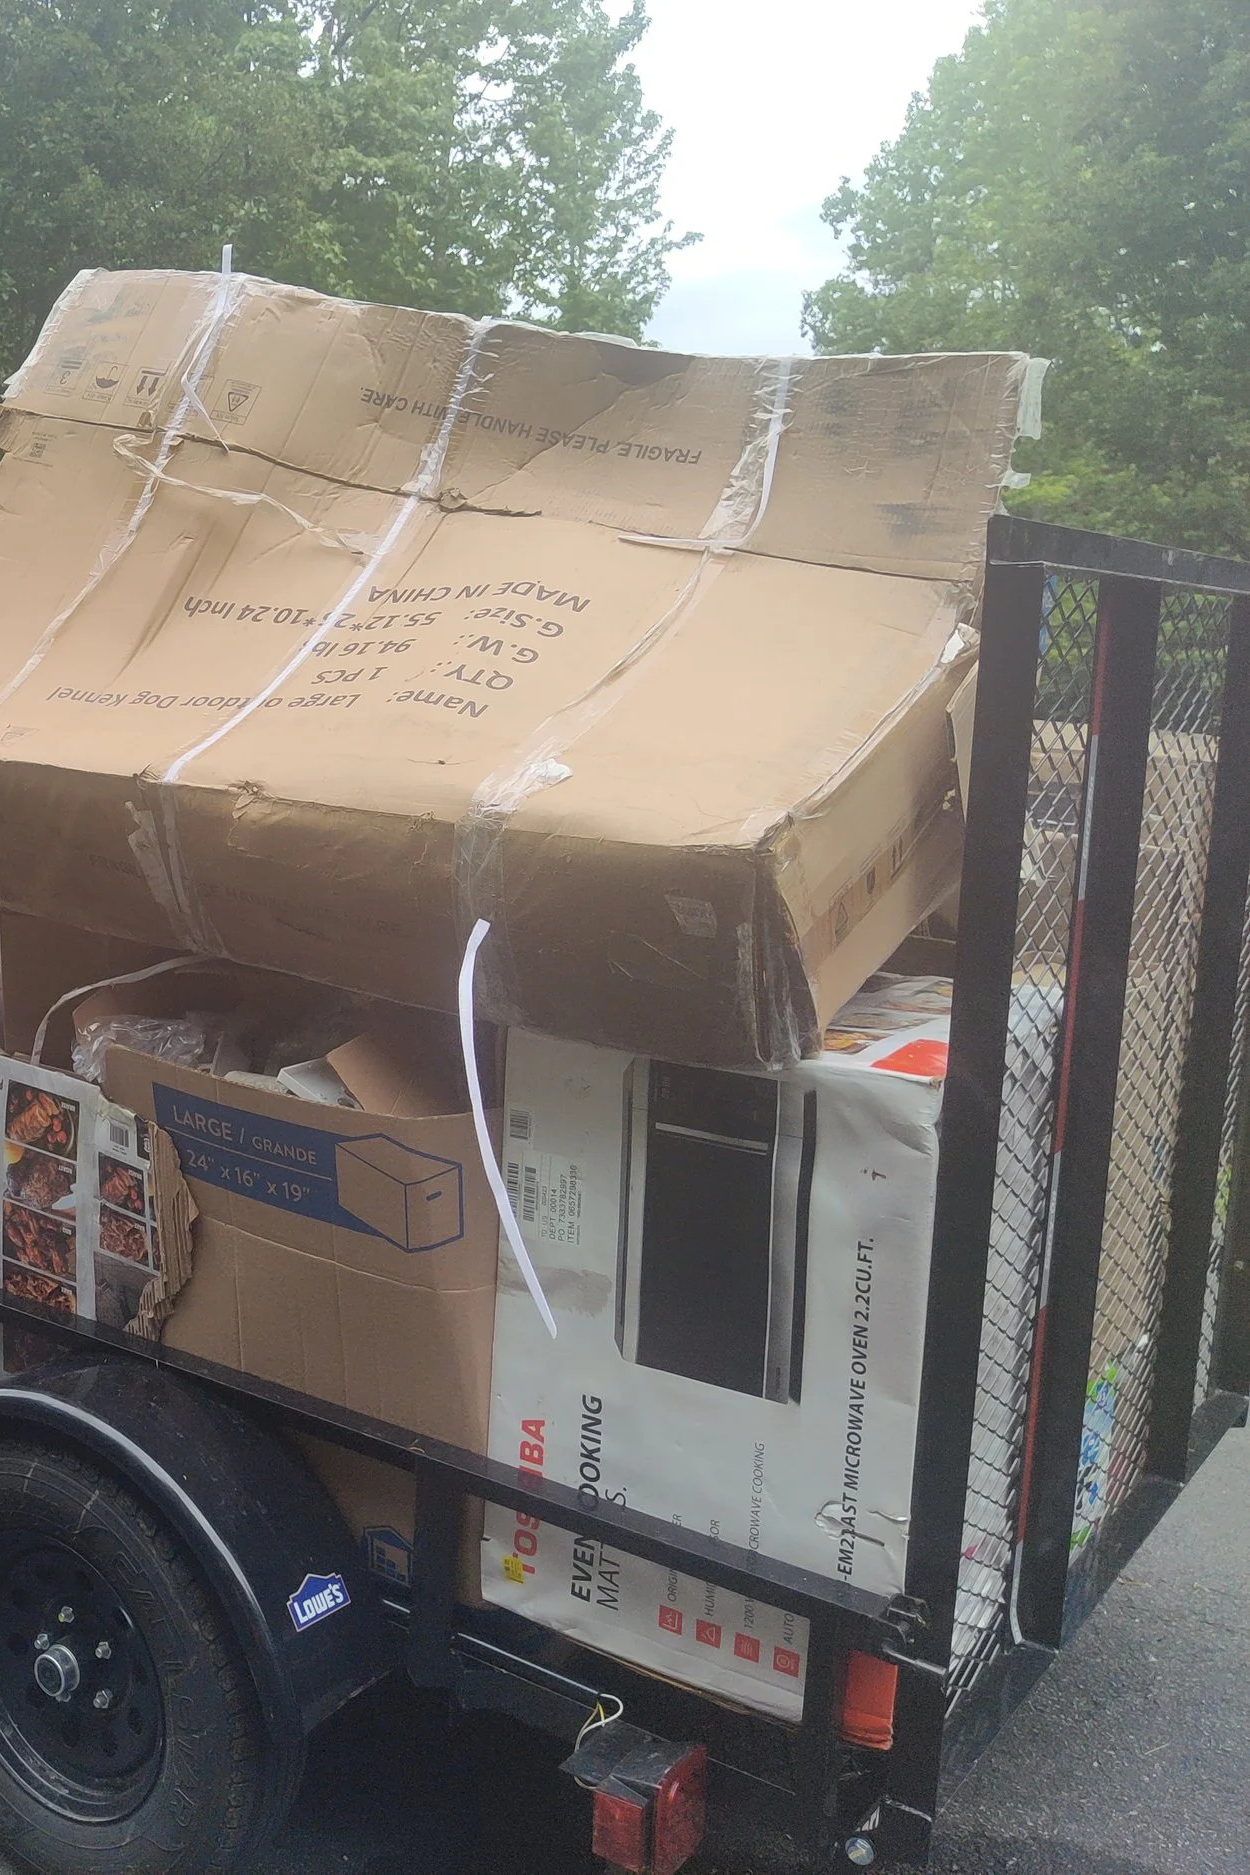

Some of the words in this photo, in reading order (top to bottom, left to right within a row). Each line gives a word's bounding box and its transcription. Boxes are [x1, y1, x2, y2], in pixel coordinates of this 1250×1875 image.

[359, 387, 410, 412] CARE.
[452, 411, 534, 439] HANDLE
[534, 427, 611, 456] PLEASE
[367, 586, 453, 605] CHINA
[454, 583, 491, 602] IN
[492, 580, 591, 614] MADE
[182, 597, 237, 622] Inch
[463, 607, 565, 638] G.Size:
[337, 638, 417, 658] 94.16
[453, 633, 540, 664] G.W.:
[311, 668, 366, 685] PCS
[367, 666, 389, 682] 1
[45, 686, 131, 709] Kennel
[128, 690, 180, 709] Dog
[288, 692, 362, 710] Large
[385, 690, 490, 719] Name:
[171, 1104, 234, 1142] LARGE
[252, 1136, 318, 1166] GRANDE
[220, 1165, 231, 1181] x
[266, 1182, 278, 1197] x
[550, 1188, 558, 1213] 00014
[549, 1216, 557, 1240] DEPT
[558, 1228, 566, 1242] PO
[567, 1221, 575, 1243] ITEM
[853, 1237, 875, 1323] 2.2CU.FT.
[850, 1323, 869, 1376] OVEN
[843, 1378, 867, 1492] MICROWAVE
[751, 1441, 765, 1495] COOKING
[293, 1583, 345, 1625] LOWE'S
